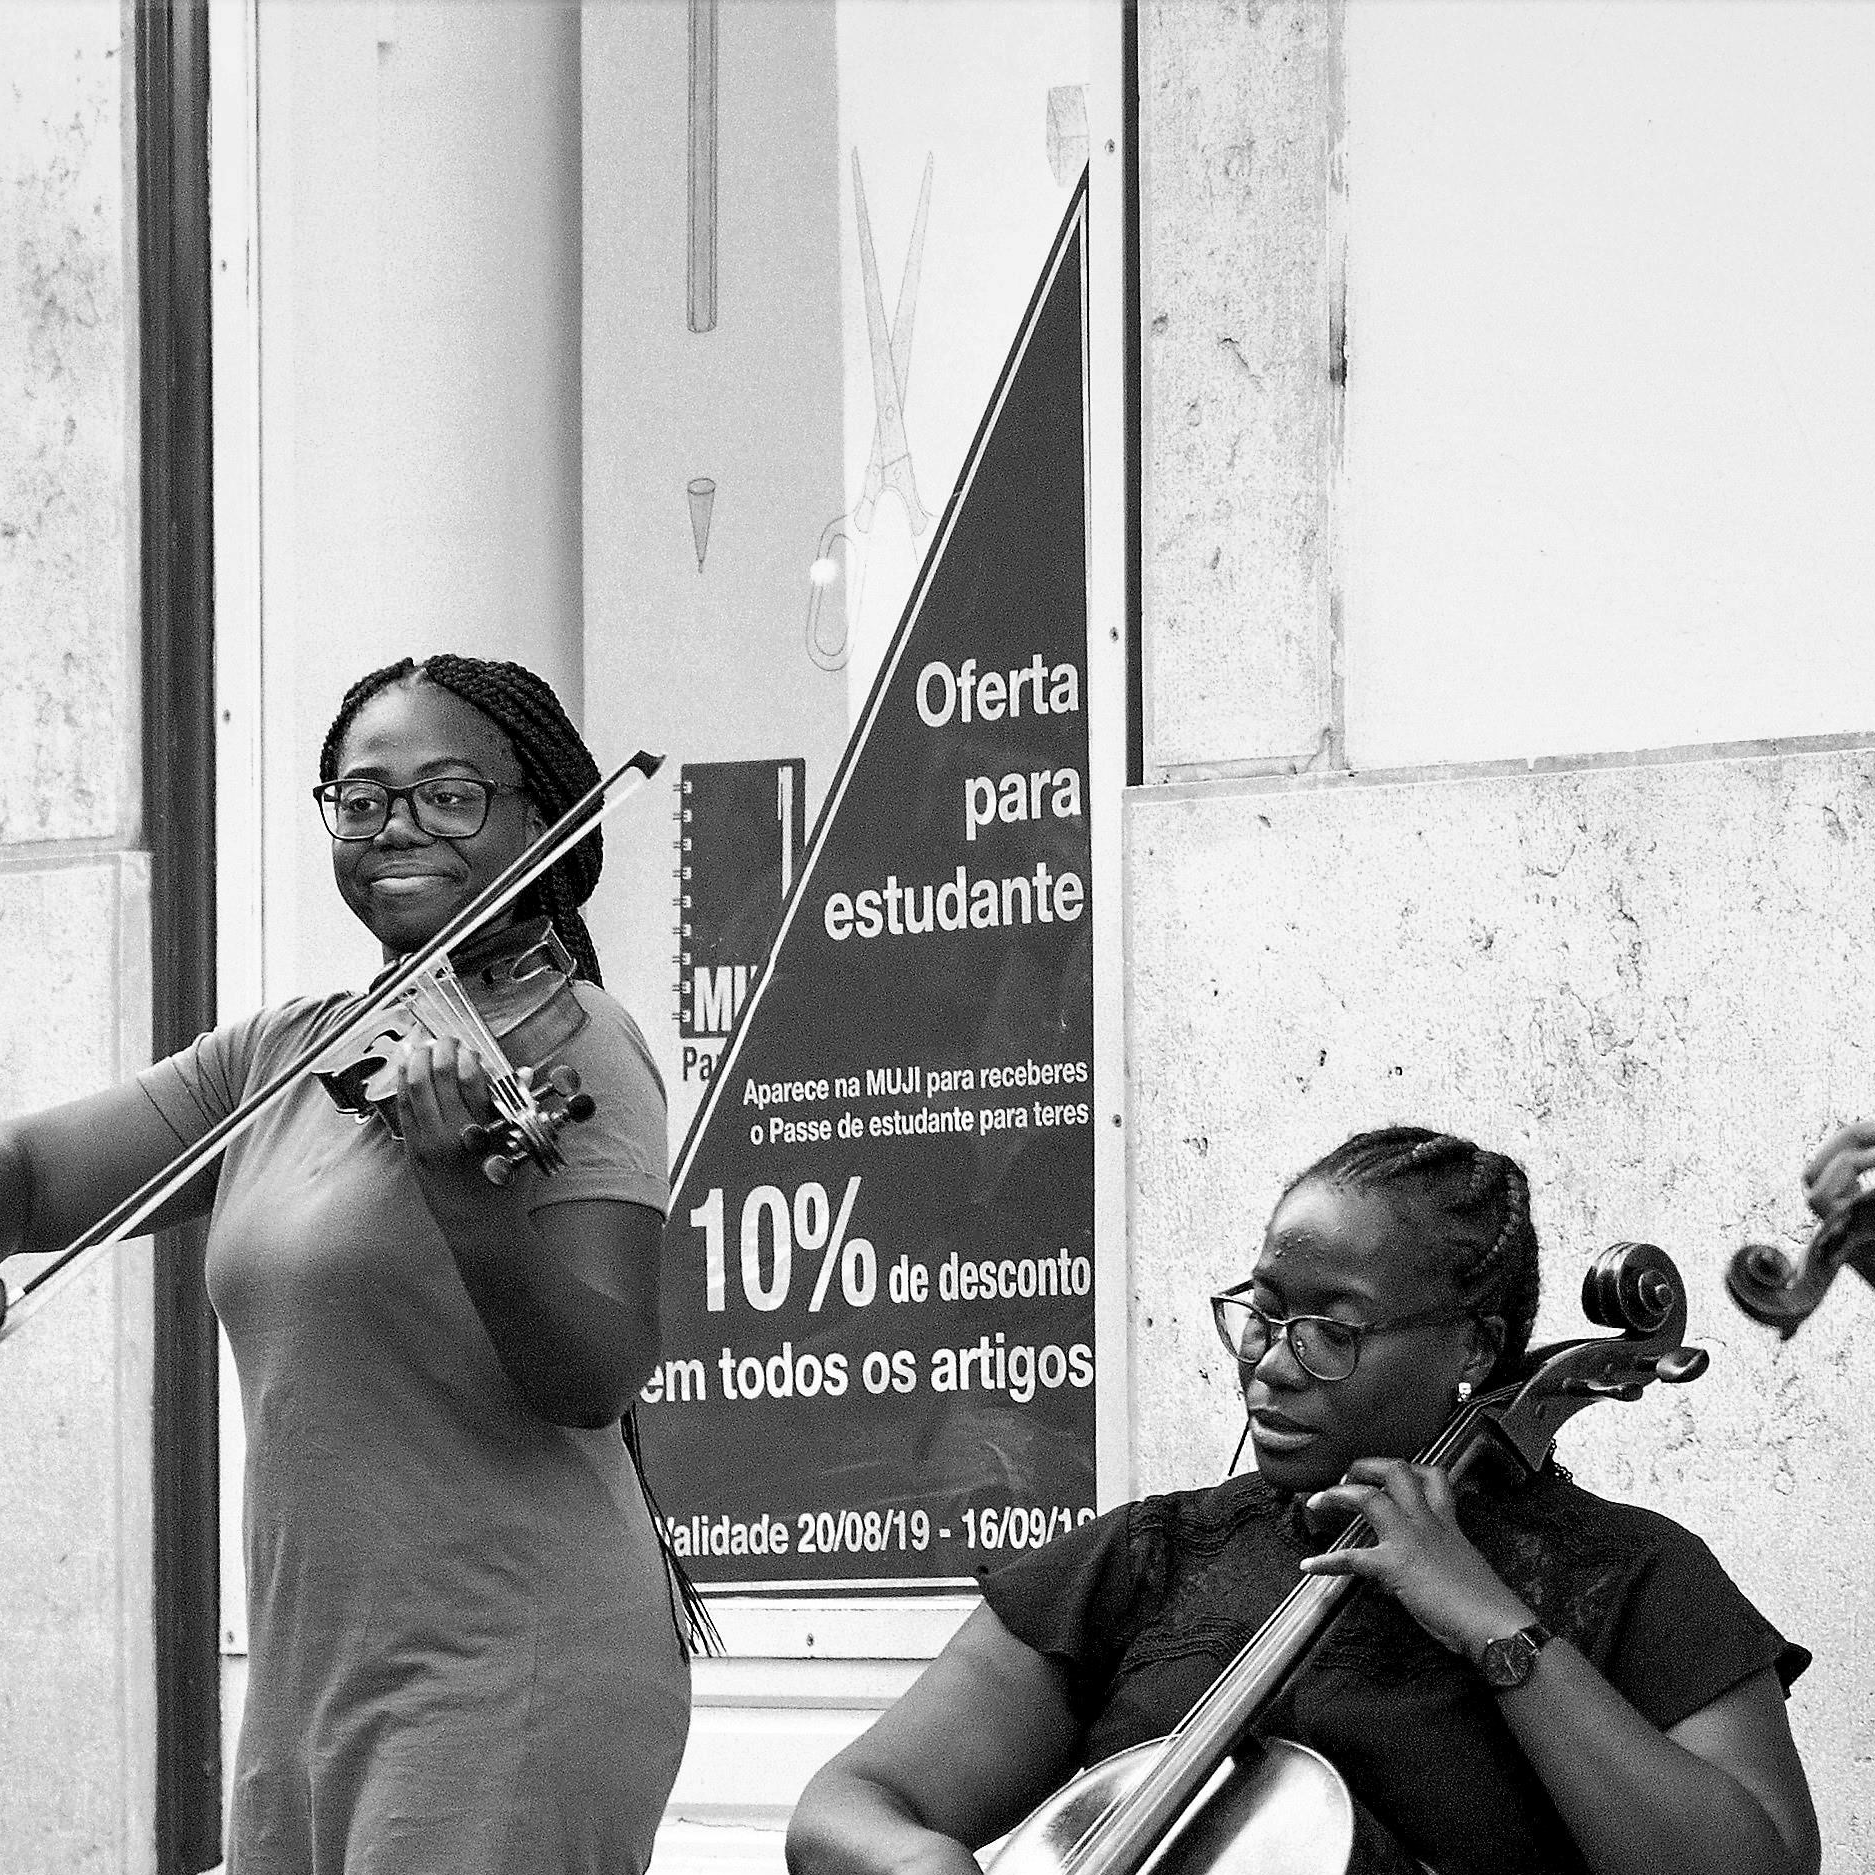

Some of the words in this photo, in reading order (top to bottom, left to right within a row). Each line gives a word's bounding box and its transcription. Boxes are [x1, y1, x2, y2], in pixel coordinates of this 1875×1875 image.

[916, 653, 1079, 728] Oferta
[965, 768, 1082, 841] para
[824, 862, 1084, 941] estudante
[743, 1078, 830, 1110] Aparece
[834, 1076, 861, 1098] na
[866, 1066, 921, 1096] MUJI
[927, 1066, 975, 1099] para
[980, 1058, 1088, 1090] receberes
[750, 1124, 764, 1145] o
[769, 1116, 832, 1144] Passe
[837, 1112, 864, 1139] de
[869, 1104, 975, 1137] estudante
[979, 1104, 1028, 1136] para
[1033, 1101, 1089, 1127] teres
[690, 1176, 877, 1313] 10%
[888, 1254, 929, 1304] de
[939, 1247, 1091, 1301] desconto
[718, 1341, 849, 1400] todos
[862, 1350, 917, 1394] os
[930, 1332, 1094, 1403] artigos
[797, 1509, 930, 1553] 20/08/19
[939, 1528, 951, 1538] -
